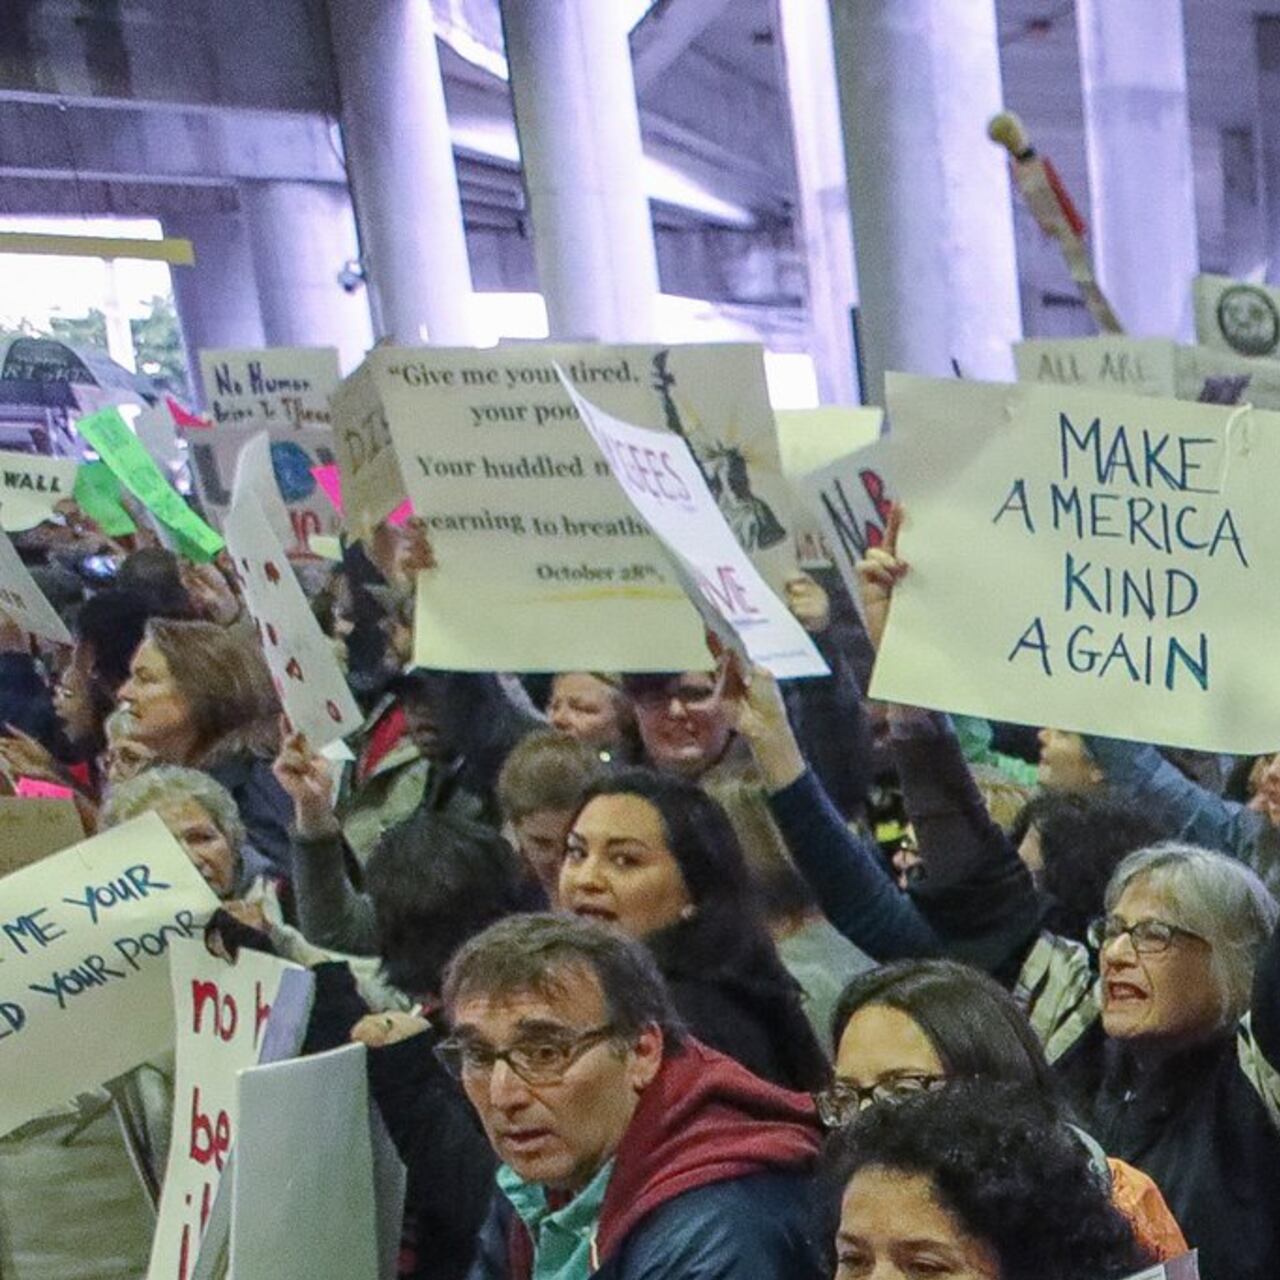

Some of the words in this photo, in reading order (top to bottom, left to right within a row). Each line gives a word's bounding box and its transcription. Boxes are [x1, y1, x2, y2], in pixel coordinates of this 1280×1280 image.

[462, 369, 498, 386] me
[470, 405, 528, 427] your
[535, 406, 582, 424] poo
[3, 470, 61, 492] WALL
[416, 456, 474, 478] Your
[485, 456, 583, 479] huddled
[1059, 412, 1220, 494] MAKE
[532, 515, 558, 536] to
[992, 478, 1249, 568] AMERICA
[536, 563, 613, 581] October
[1064, 552, 1199, 620] KIND
[1008, 617, 1209, 691] AGAIN
[3, 907, 67, 955] ME
[62, 865, 171, 925] YOUR
[28, 954, 127, 1010] YOUR
[191, 979, 238, 1042] no
